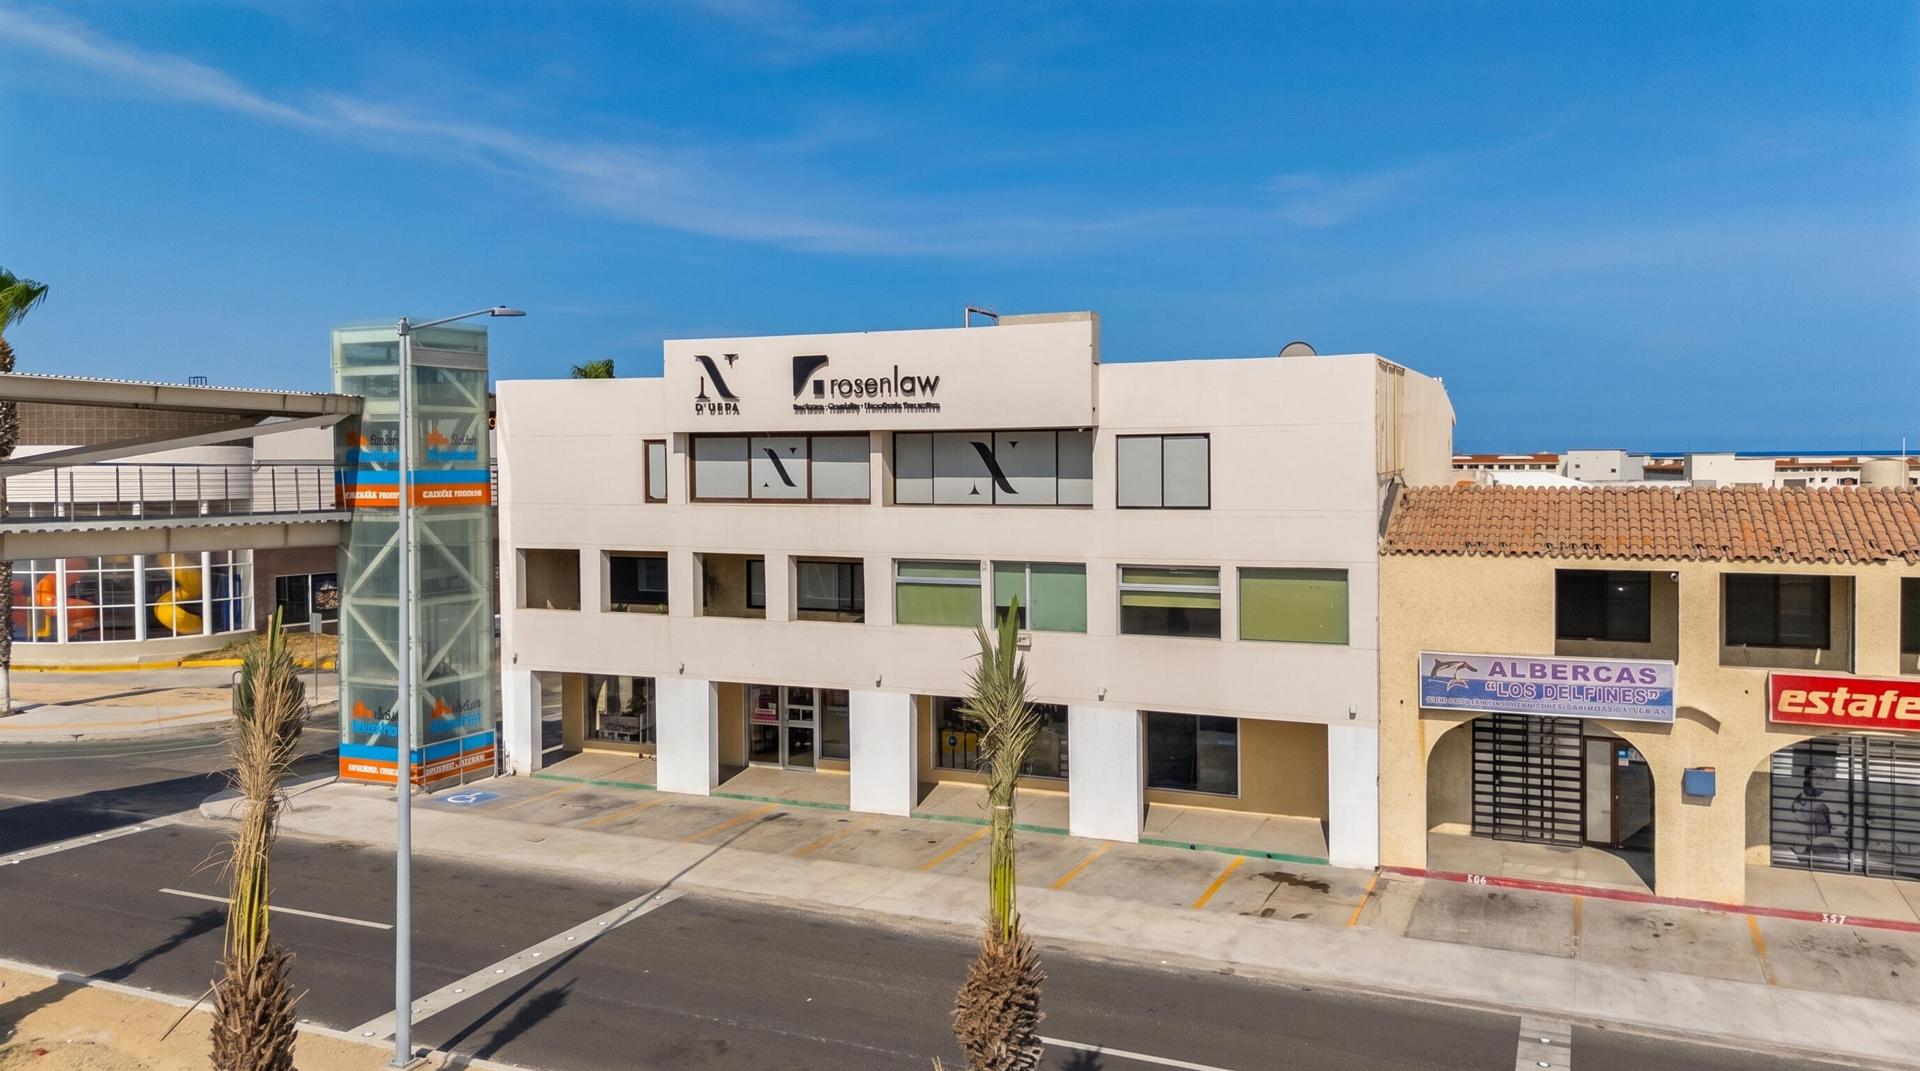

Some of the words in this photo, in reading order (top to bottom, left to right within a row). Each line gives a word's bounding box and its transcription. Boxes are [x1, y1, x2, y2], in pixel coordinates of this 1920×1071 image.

[694, 354, 740, 399] N
[830, 365, 940, 397] rosenlaw
[1488, 661, 1657, 685] ALBERCAS
[1777, 686, 1920, 720] estafe
